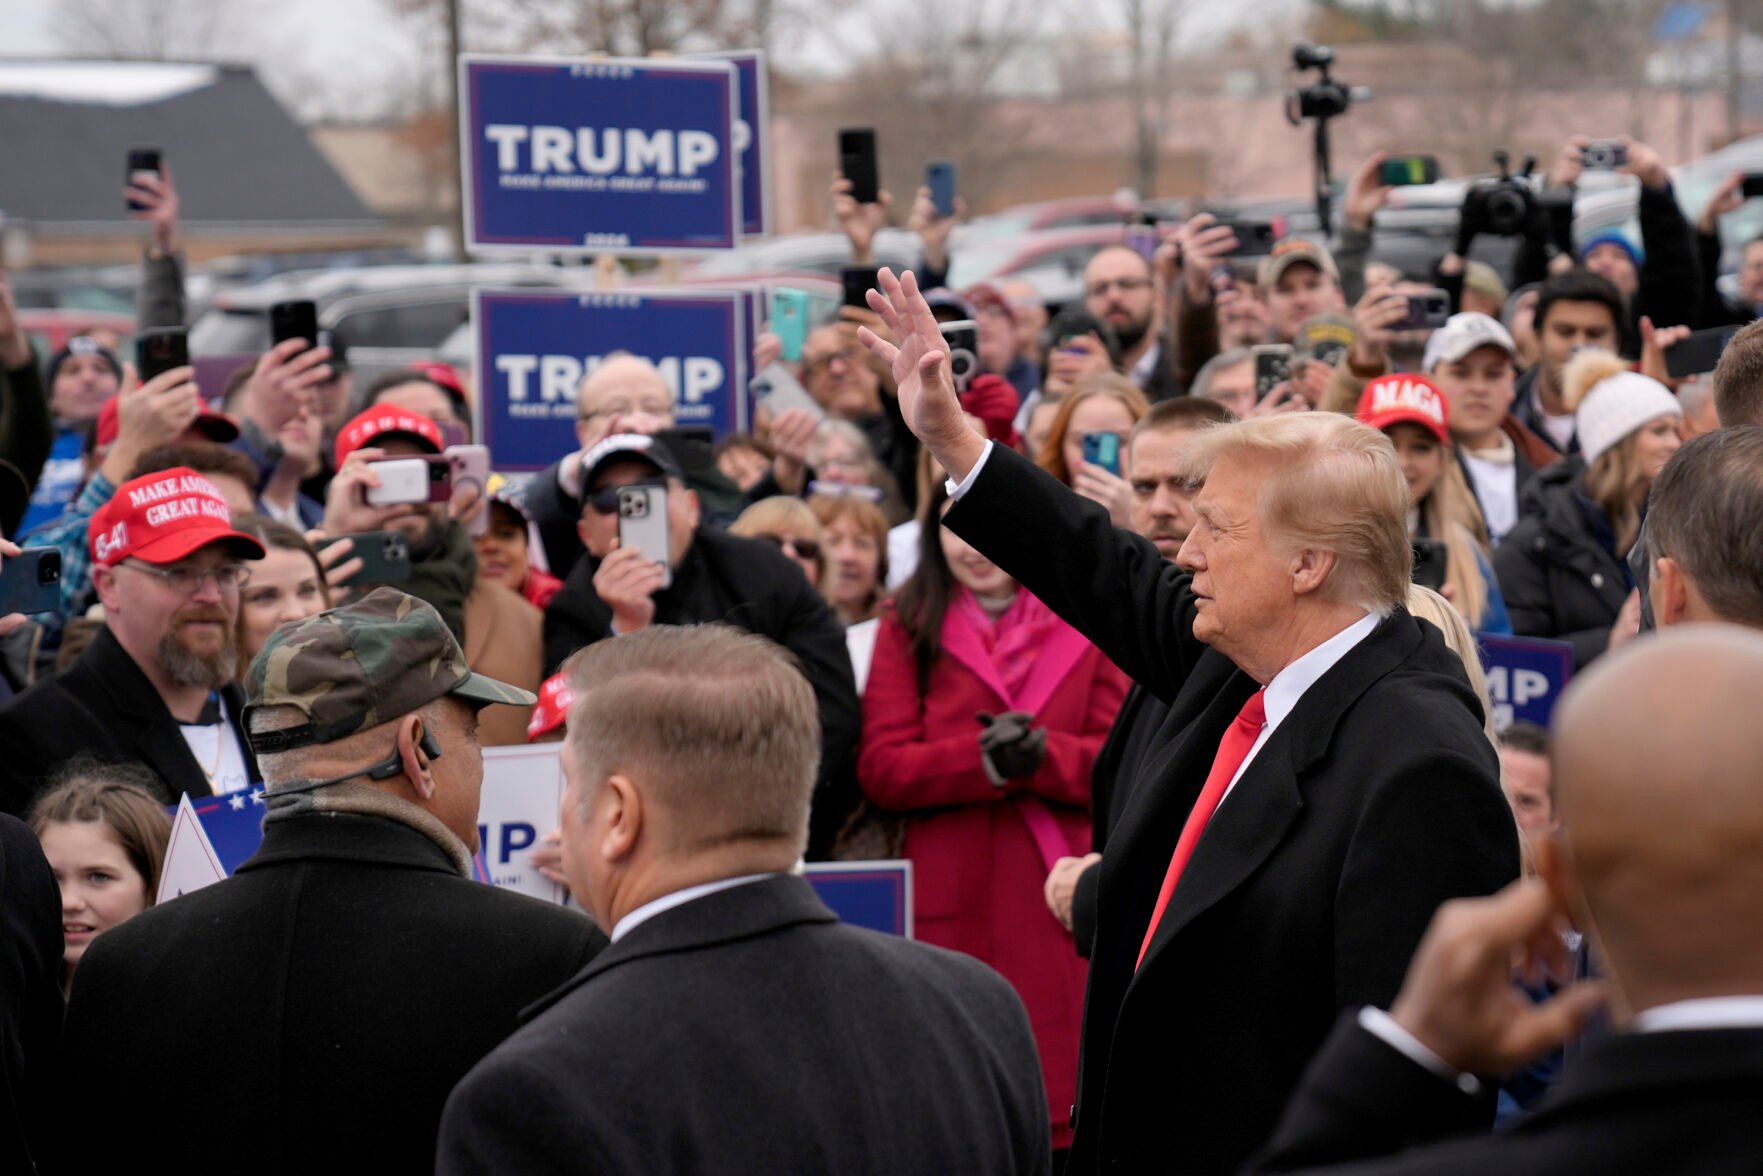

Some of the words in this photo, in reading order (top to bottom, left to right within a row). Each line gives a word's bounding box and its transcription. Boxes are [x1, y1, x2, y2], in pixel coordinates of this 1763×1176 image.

[485, 124, 719, 176] TRUMP
[496, 354, 724, 402] TRMP
[1371, 380, 1444, 424] MAGA
[128, 478, 179, 508] MAKE
[146, 497, 200, 527] GREAT
